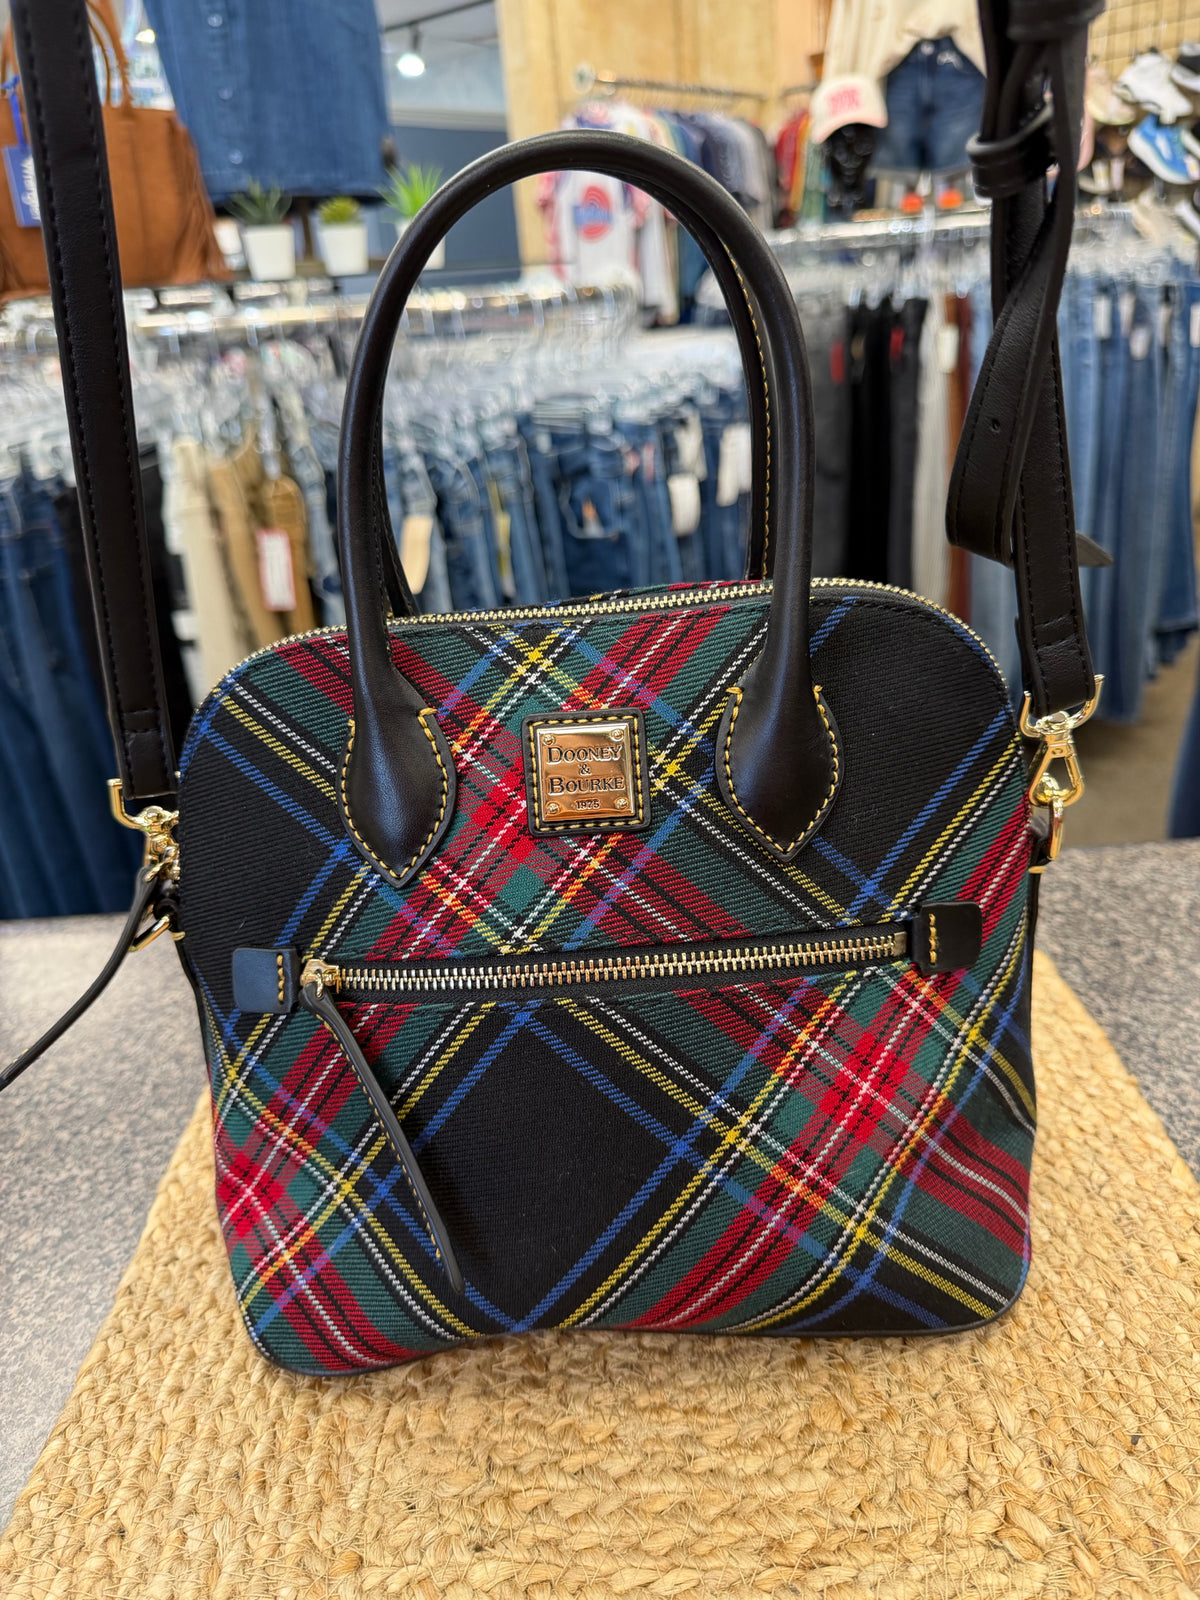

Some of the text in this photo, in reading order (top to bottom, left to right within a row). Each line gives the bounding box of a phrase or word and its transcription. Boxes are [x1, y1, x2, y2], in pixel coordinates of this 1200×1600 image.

[547, 745, 622, 764] DOONEY
[580, 763, 591, 775] &
[548, 776, 625, 795] BOURKE
[576, 799, 600, 810] 1975
